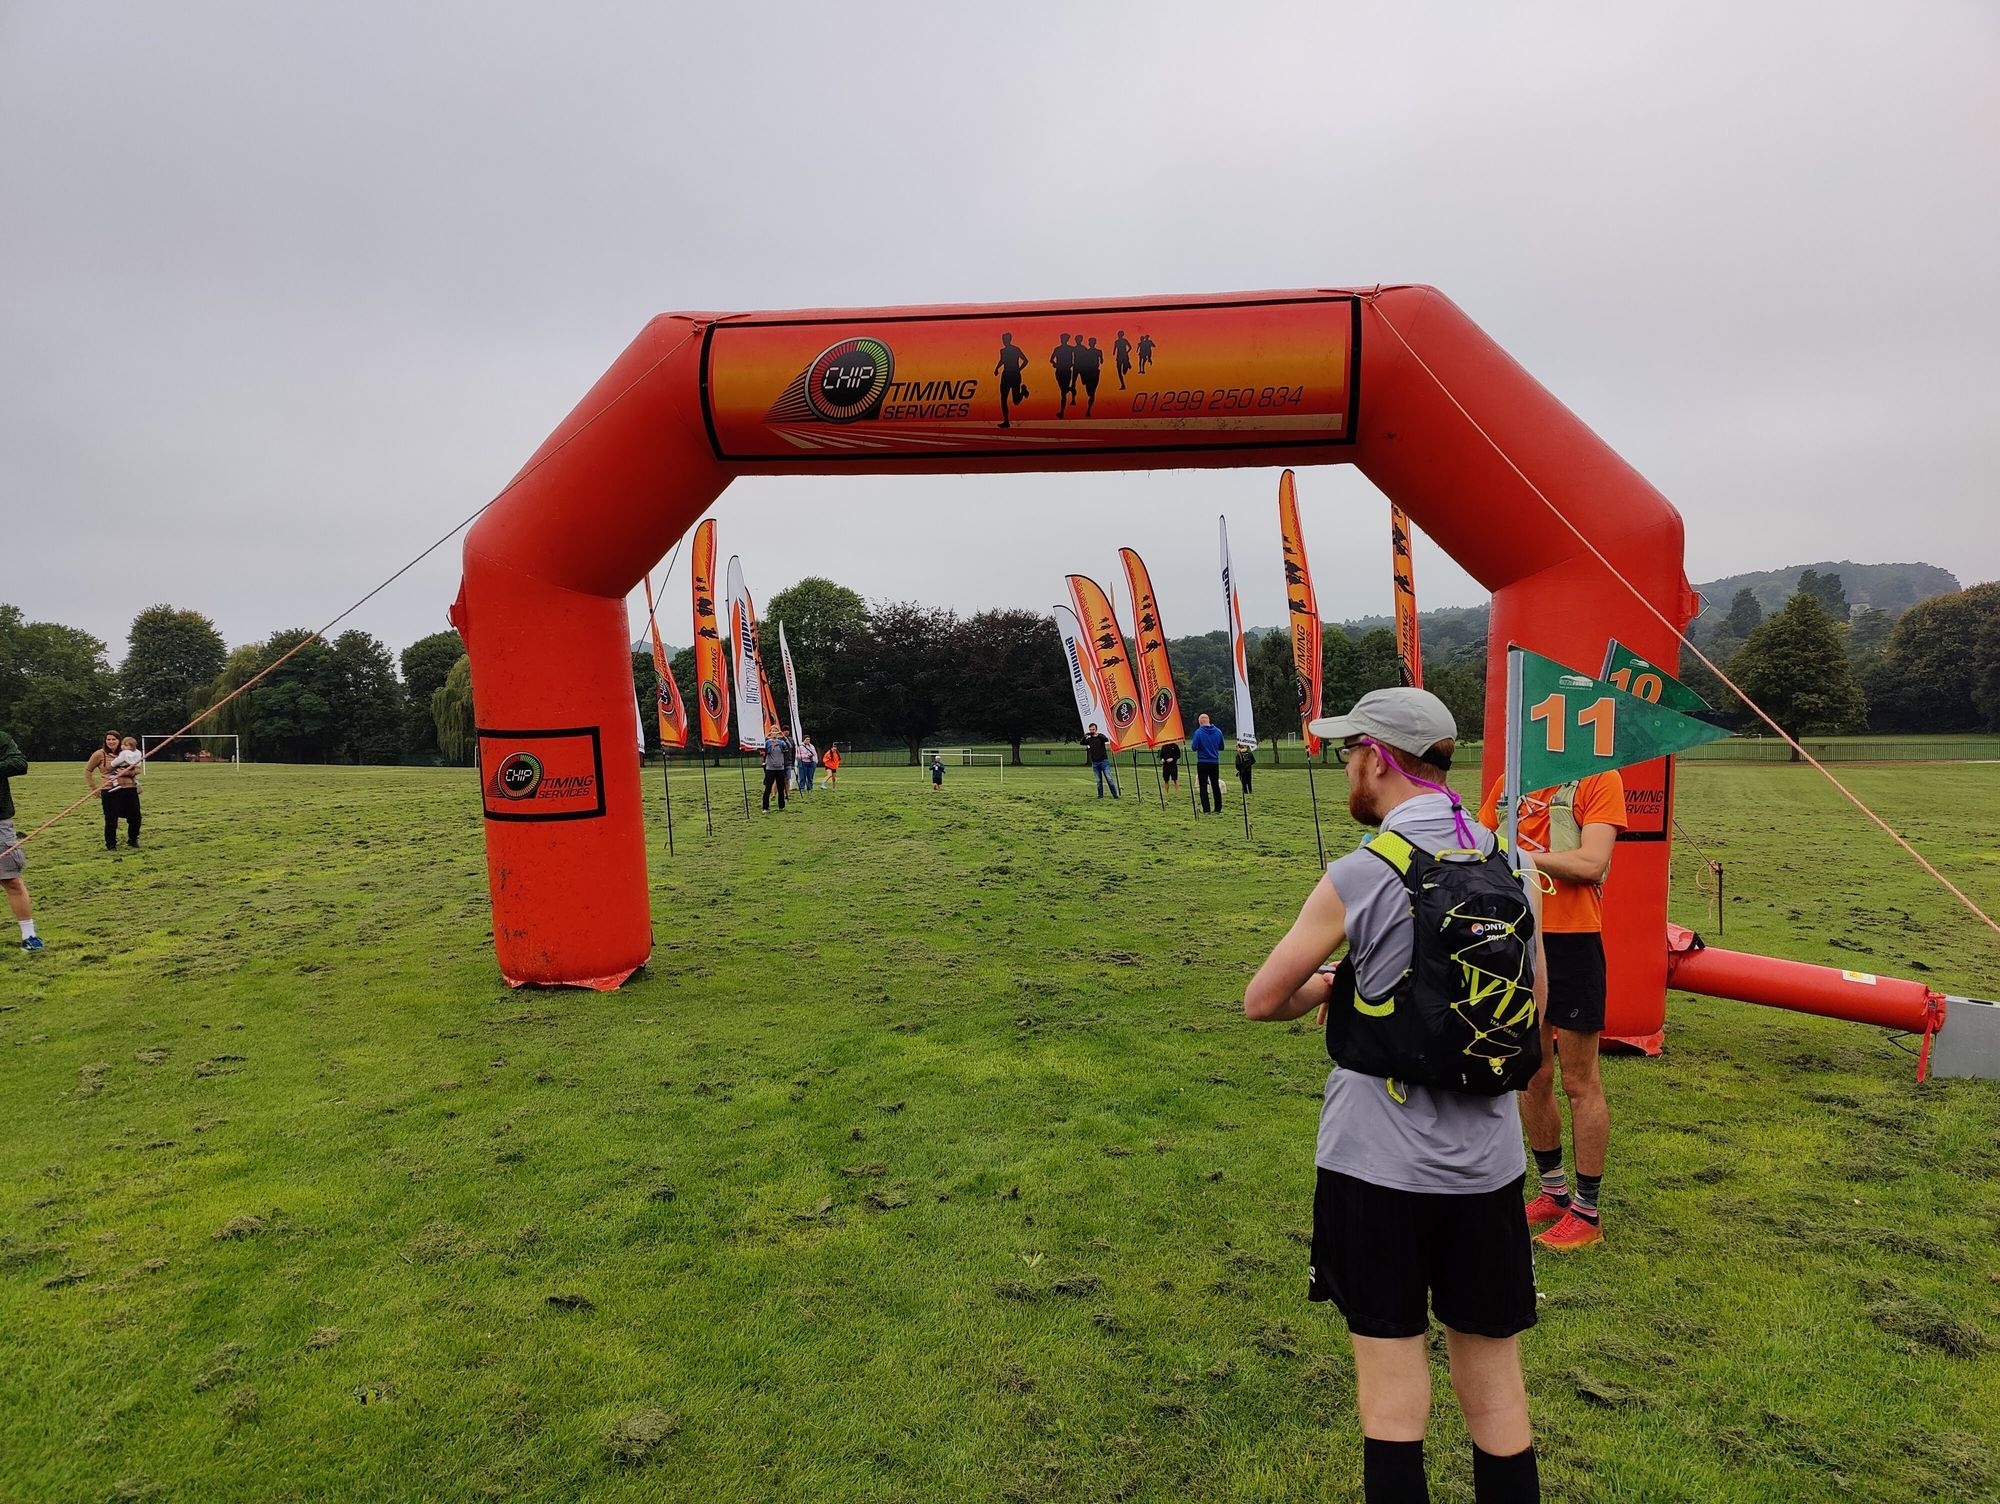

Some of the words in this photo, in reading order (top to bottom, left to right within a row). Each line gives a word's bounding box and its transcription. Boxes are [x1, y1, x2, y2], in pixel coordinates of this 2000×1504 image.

[823, 366, 875, 390] CHIP
[890, 379, 978, 403] TIMING
[1131, 390, 1205, 413] 01299
[1207, 388, 1255, 410] 250
[1257, 385, 1304, 408] 834
[882, 402, 971, 421] SERVICES
[1296, 624, 1306, 671] TIMING
[1610, 666, 1663, 704] 10
[1530, 693, 1616, 757] 11
[505, 769, 533, 782] CHIP
[541, 774, 595, 789] TIMING
[537, 787, 591, 799] SERVICES
[1625, 804, 1661, 815] RVICES
